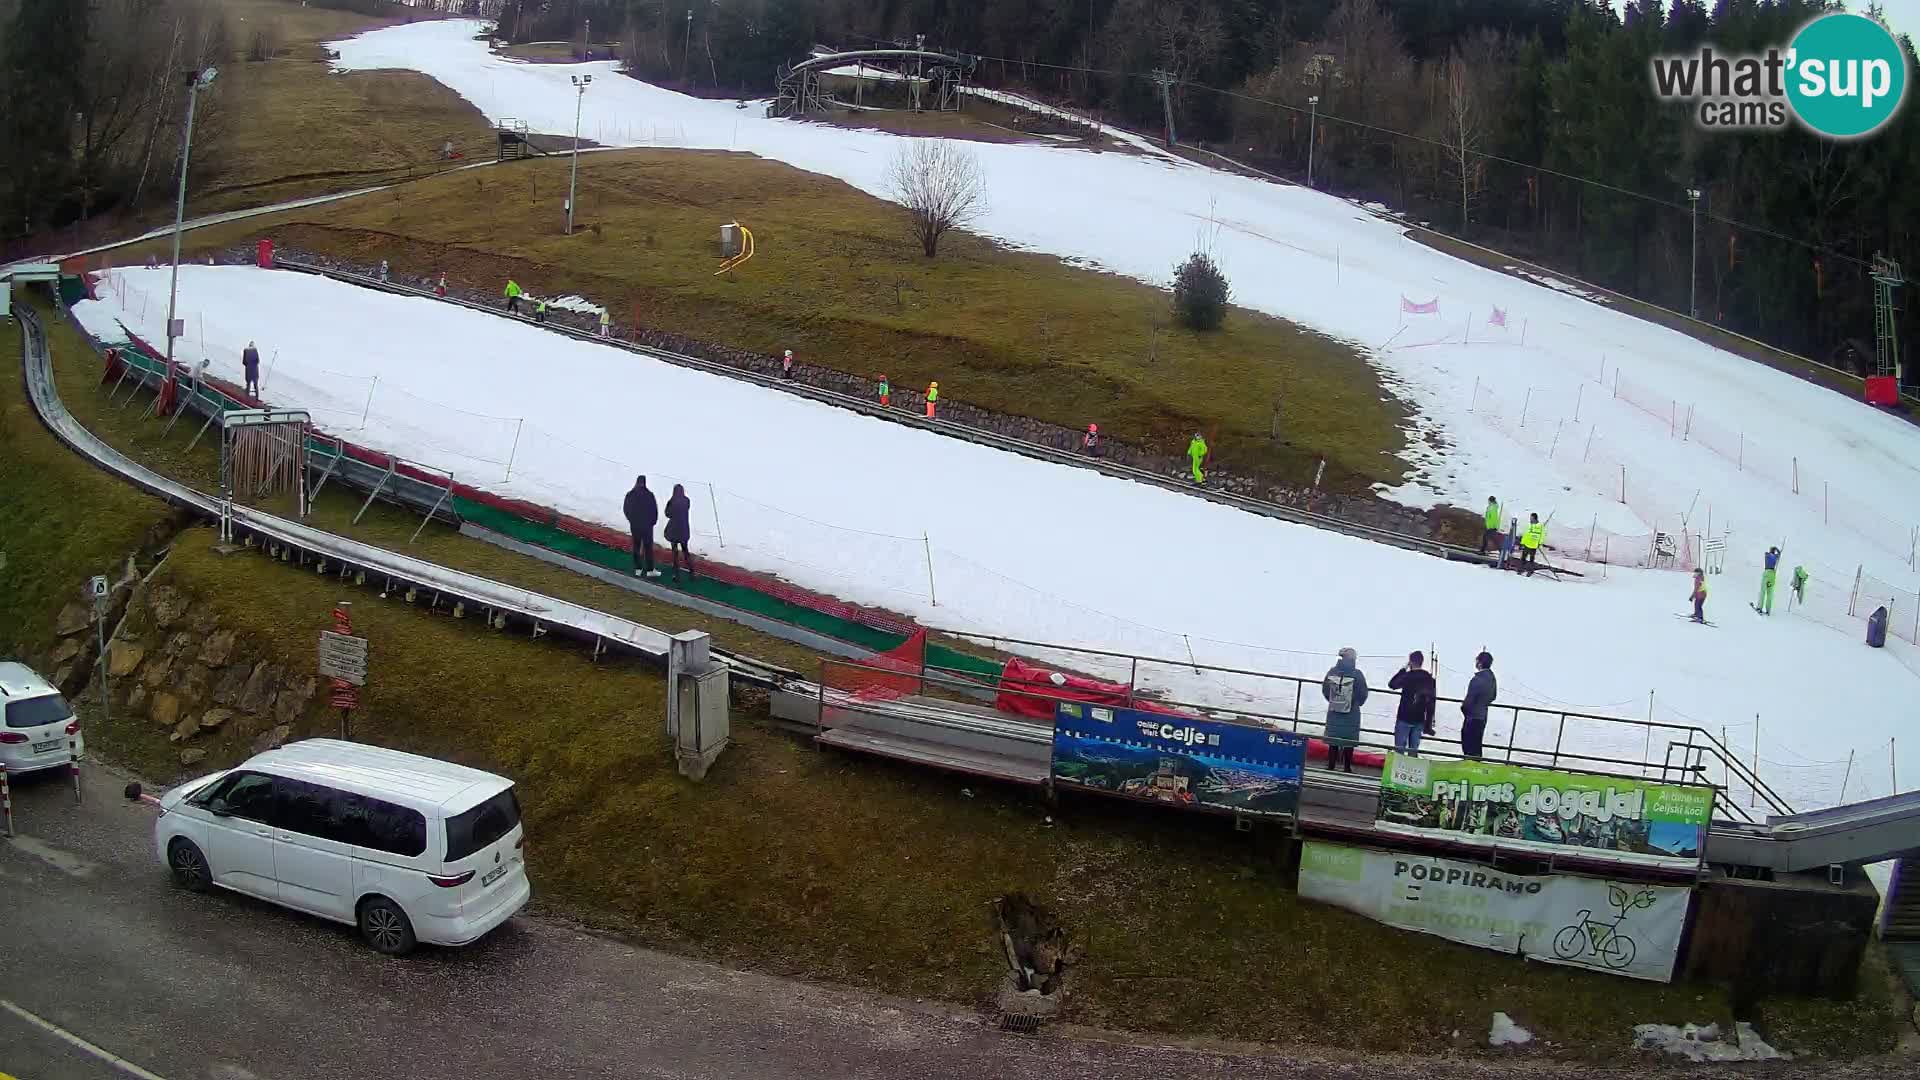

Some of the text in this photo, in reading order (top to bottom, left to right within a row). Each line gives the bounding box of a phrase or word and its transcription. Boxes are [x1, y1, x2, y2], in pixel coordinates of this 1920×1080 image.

[1160, 724, 1206, 746] Celje
[1431, 779, 1468, 802] Pri
[1472, 780, 1516, 803] nas
[1394, 861, 1542, 894] PODPIRAMO
